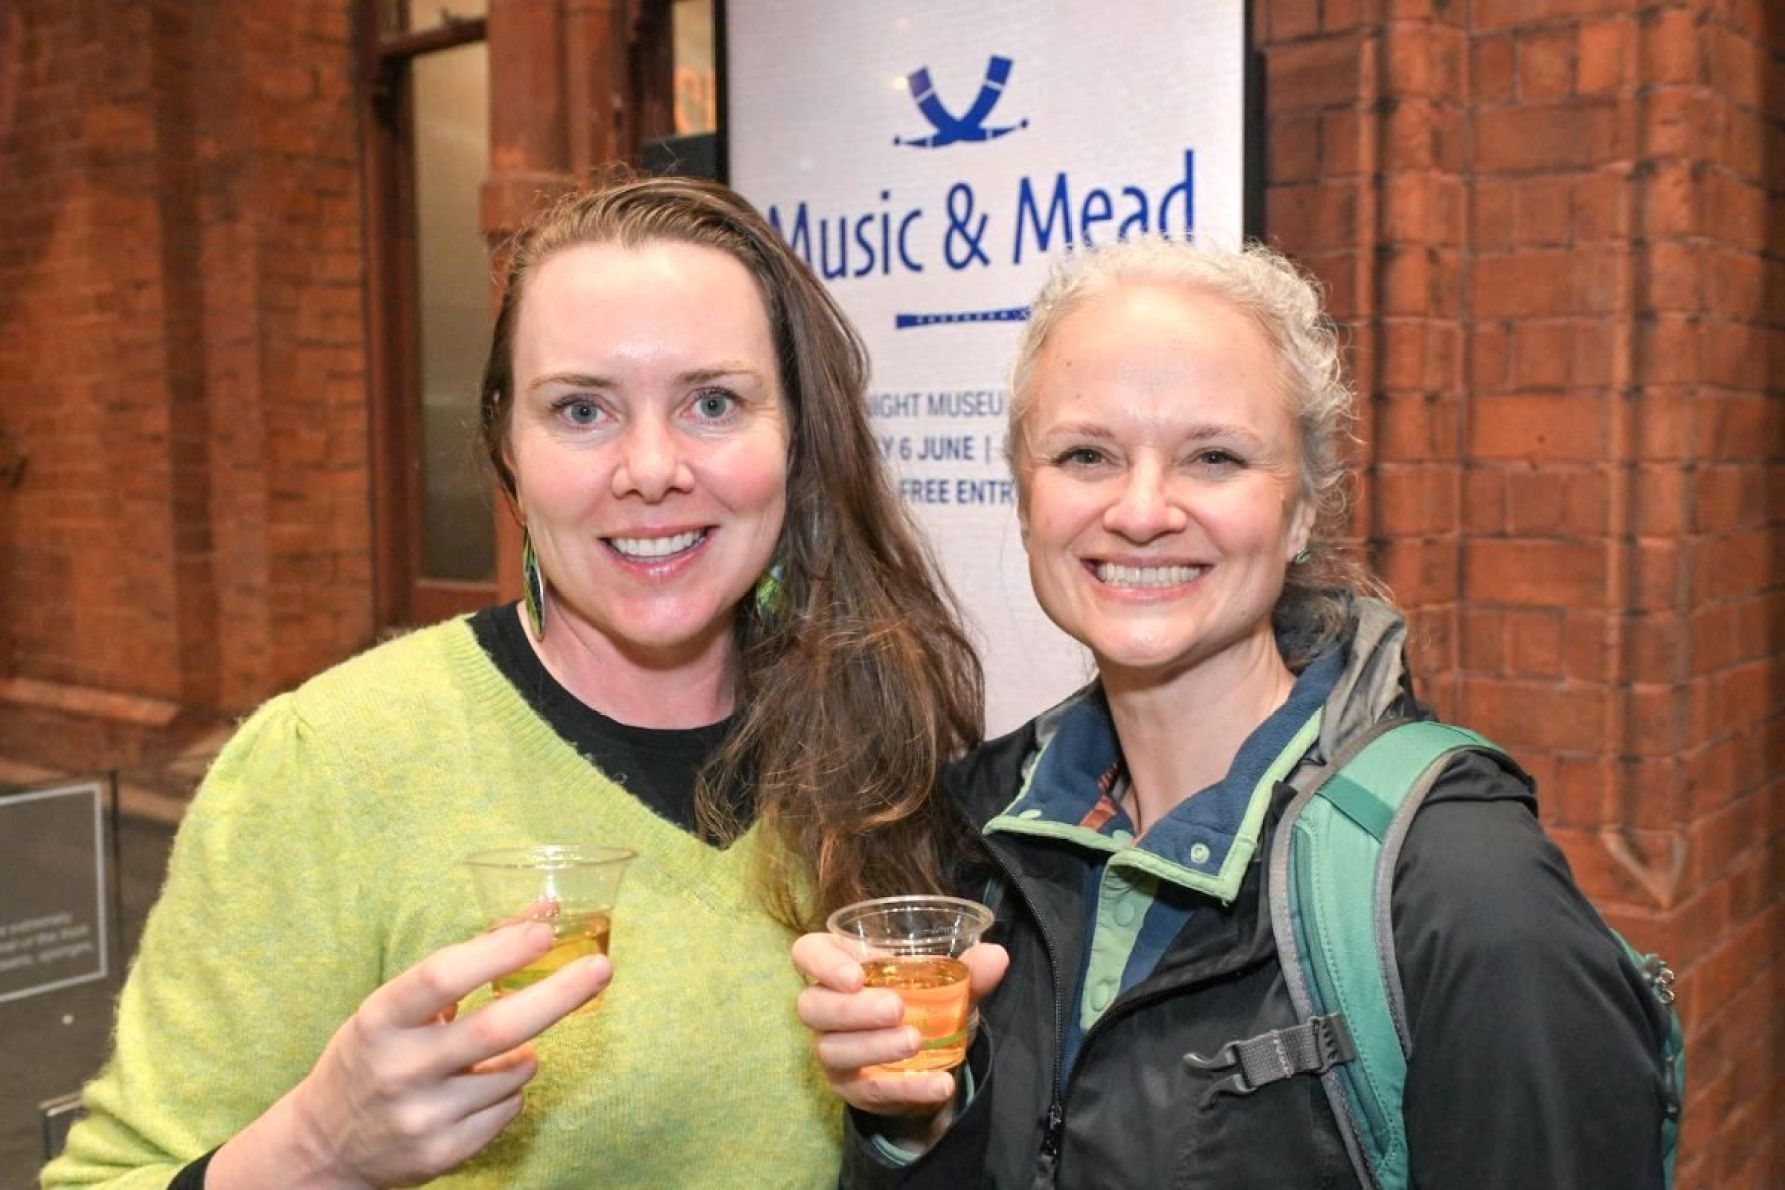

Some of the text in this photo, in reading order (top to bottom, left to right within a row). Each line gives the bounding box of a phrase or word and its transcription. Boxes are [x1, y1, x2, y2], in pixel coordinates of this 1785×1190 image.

[769, 150, 1193, 279] Music & Mead
[900, 436, 912, 460] 6
[918, 435, 974, 461] JUNE
[900, 479, 949, 504] FREE
